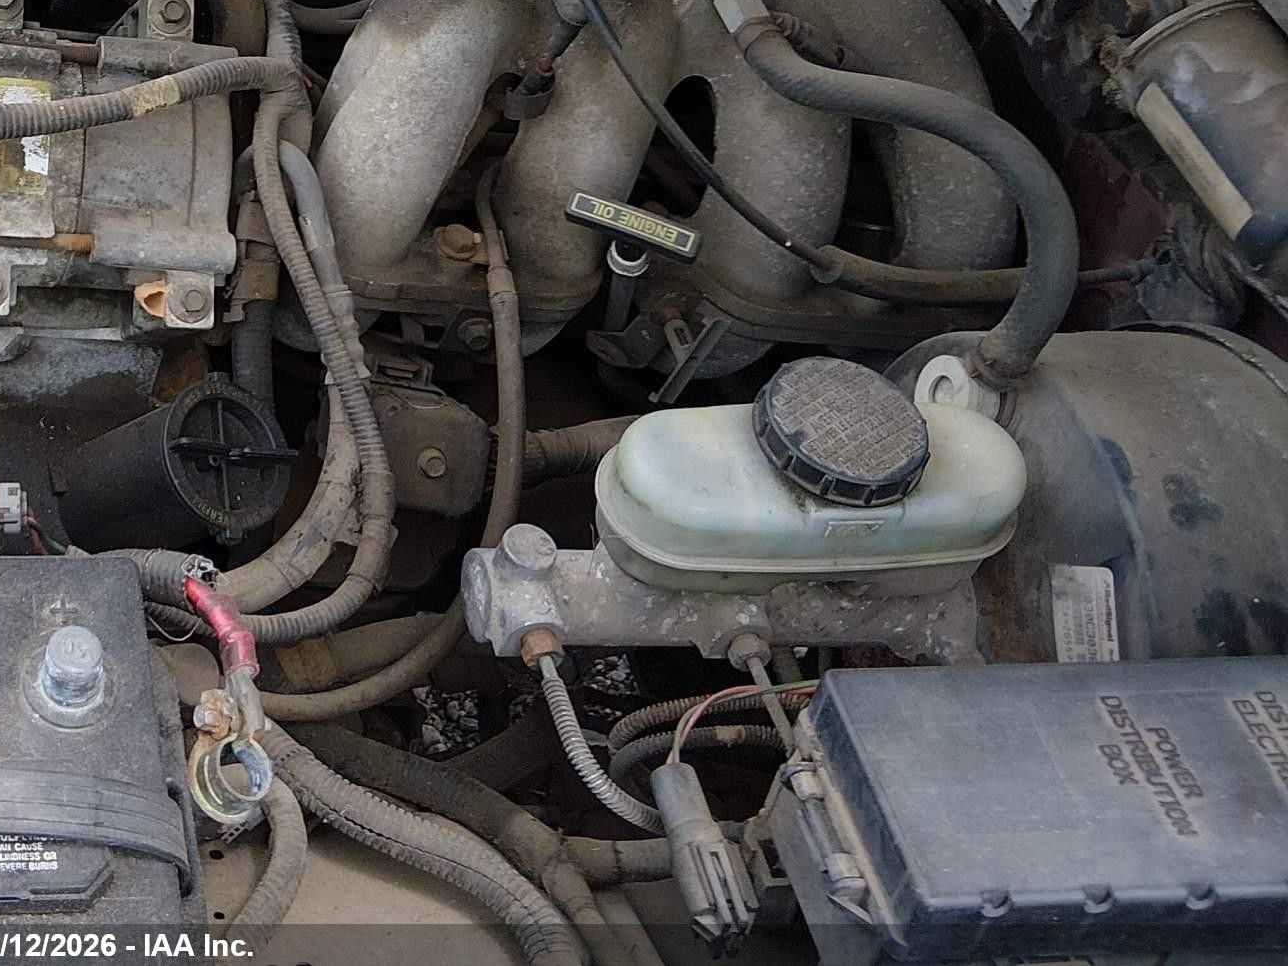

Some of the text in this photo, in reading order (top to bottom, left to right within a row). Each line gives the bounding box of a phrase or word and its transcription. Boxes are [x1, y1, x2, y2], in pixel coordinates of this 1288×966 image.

[590, 200, 678, 243] ENGINE OIL
[1104, 580, 1114, 642] AlliedSignal
[1099, 744, 1139, 786] BOX
[1099, 696, 1198, 837] DISTRIBUTION
[1145, 727, 1204, 799] POWER
[15, 842, 43, 851] CAUSE
[29, 861, 58, 870] BURNS
[43, 852, 57, 860] OR
